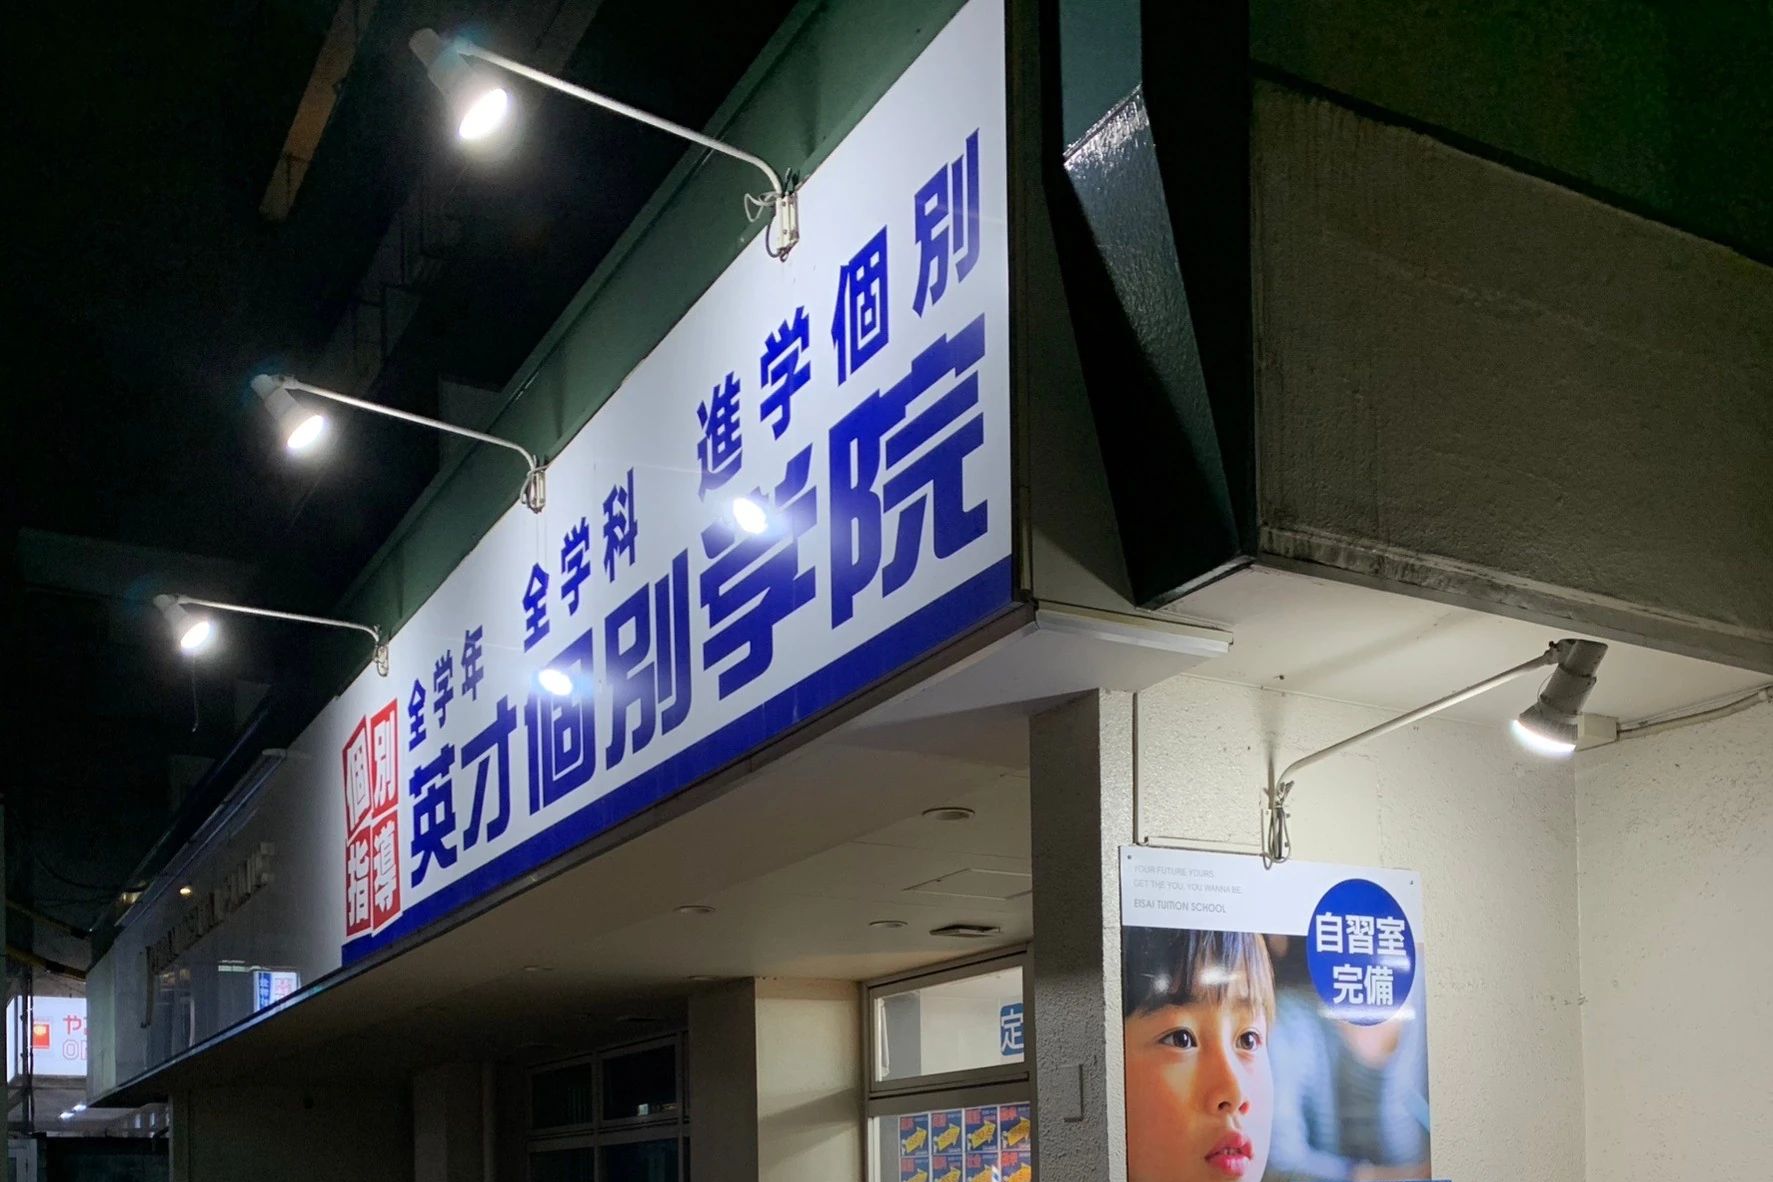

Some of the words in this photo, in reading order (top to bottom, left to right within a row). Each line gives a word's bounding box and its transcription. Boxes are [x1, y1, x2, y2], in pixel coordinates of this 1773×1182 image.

[407, 624, 485, 752] 全学年
[521, 467, 639, 652] 全学科
[696, 127, 981, 500] 進学個別
[409, 313, 989, 887] 英才個別学院
[346, 709, 396, 832] 個別
[347, 820, 397, 927] 指導
[1133, 898, 1155, 909] EISAI
[1191, 902, 1227, 914] SCHOOL
[1316, 912, 1407, 958] 自習室
[1333, 964, 1394, 1006] 完備
